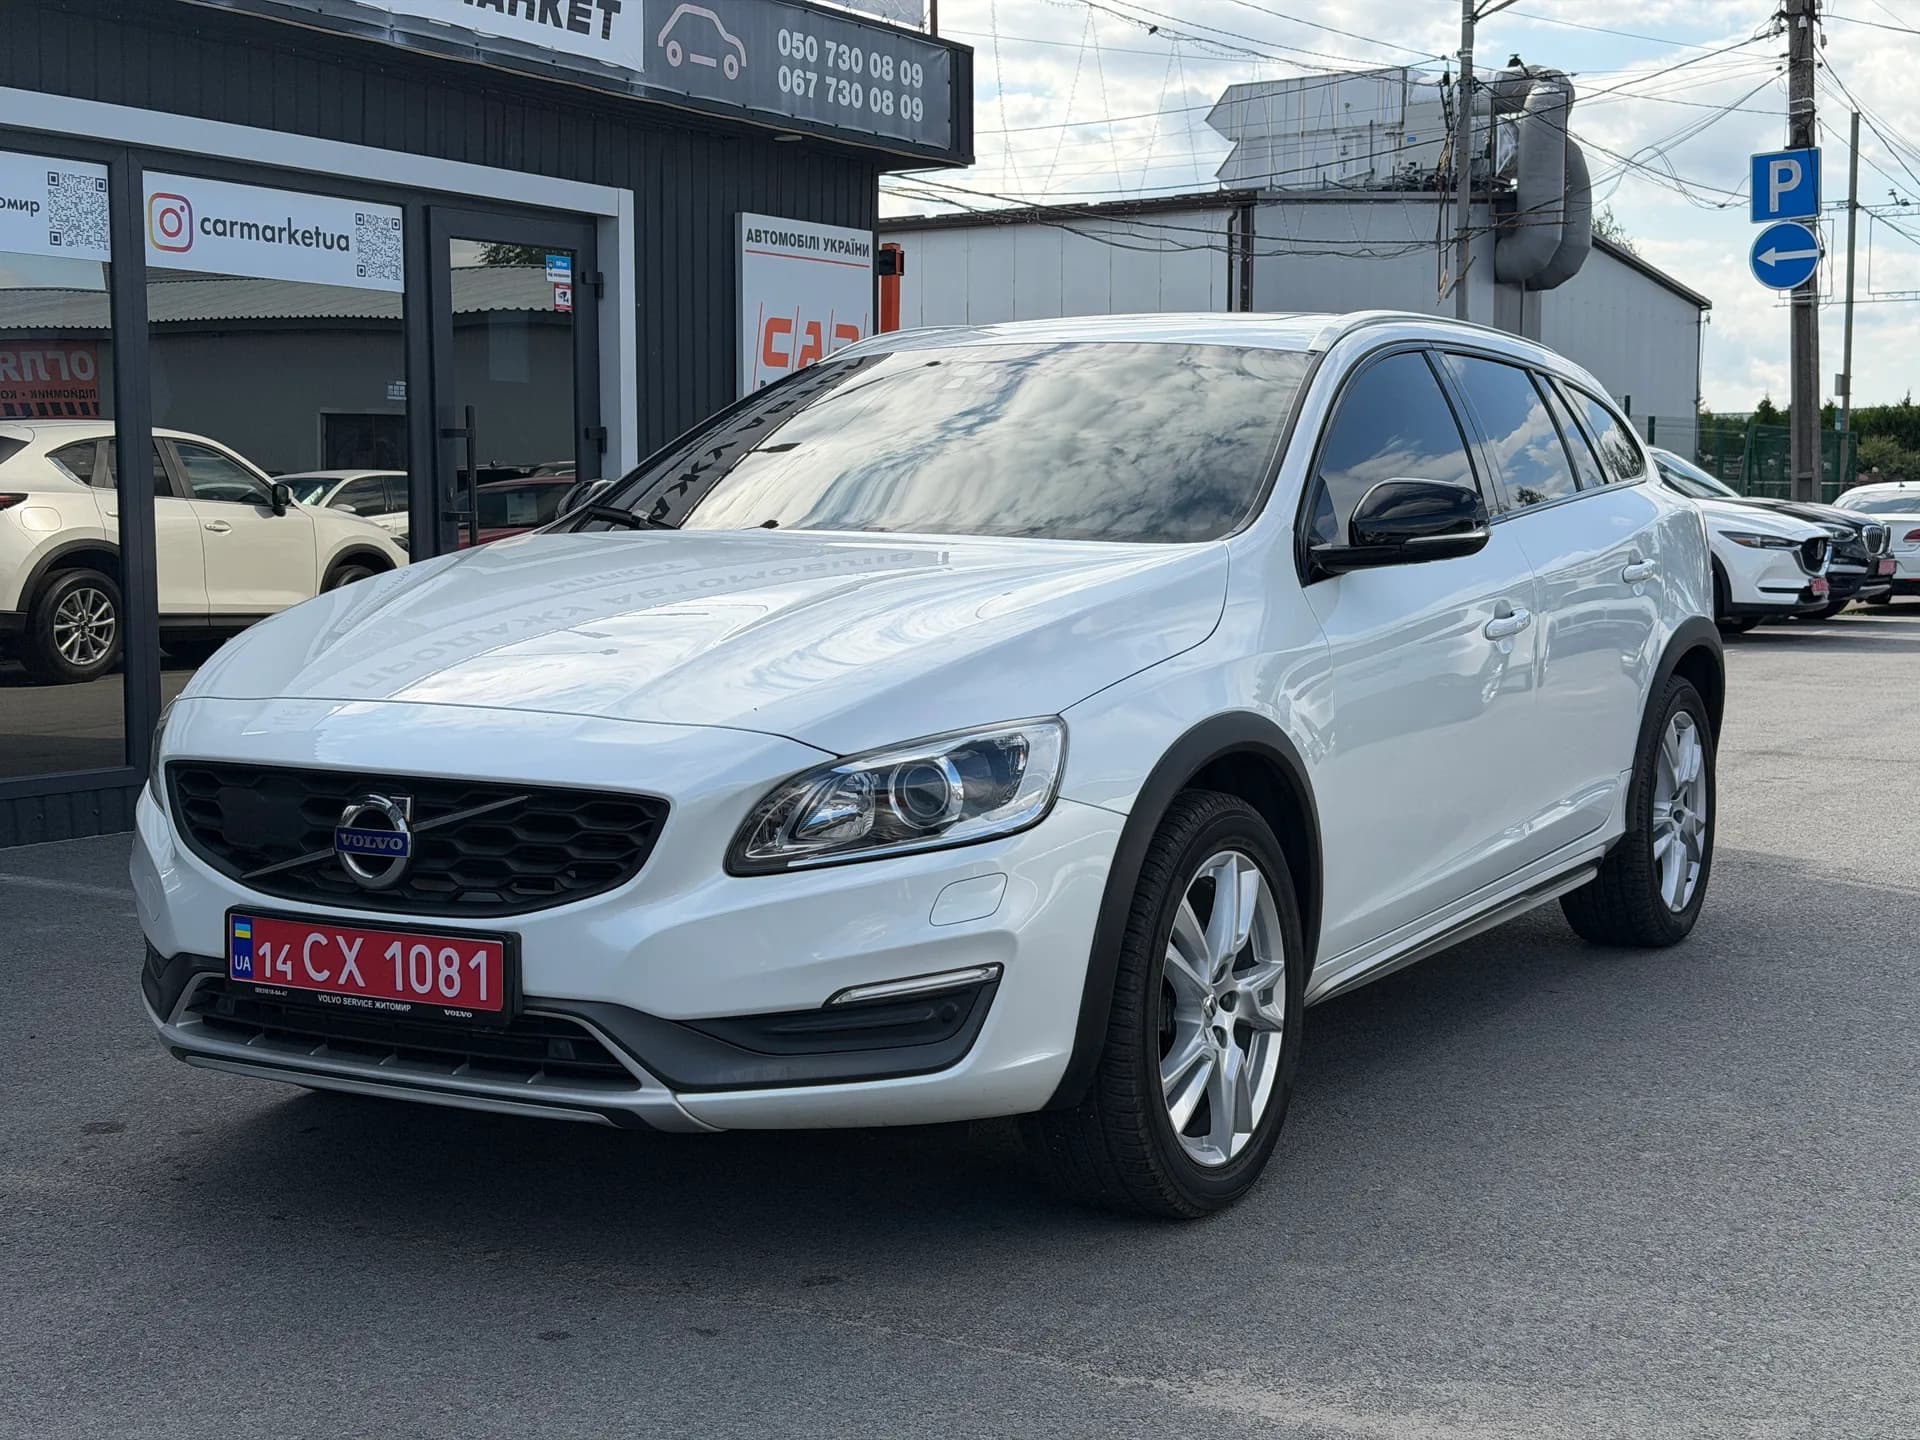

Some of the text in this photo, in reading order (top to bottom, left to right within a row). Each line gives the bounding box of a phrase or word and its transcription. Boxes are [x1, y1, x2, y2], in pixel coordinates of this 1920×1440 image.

[778, 28, 923, 88] 050 730 08 09
[778, 65, 923, 122] 067 730 08 09
[1769, 159, 1802, 213] P
[200, 216, 350, 251] carmarketua
[746, 228, 870, 258] АВТОМОБІЛІ УКРАЇНИ
[340, 833, 403, 850] VOLVO
[235, 954, 251, 971] UA
[384, 940, 488, 1001] 1081
[318, 994, 412, 1013] VOLVO SERVICE ЖИТОМИР
[443, 1009, 473, 1018] VOLVO
